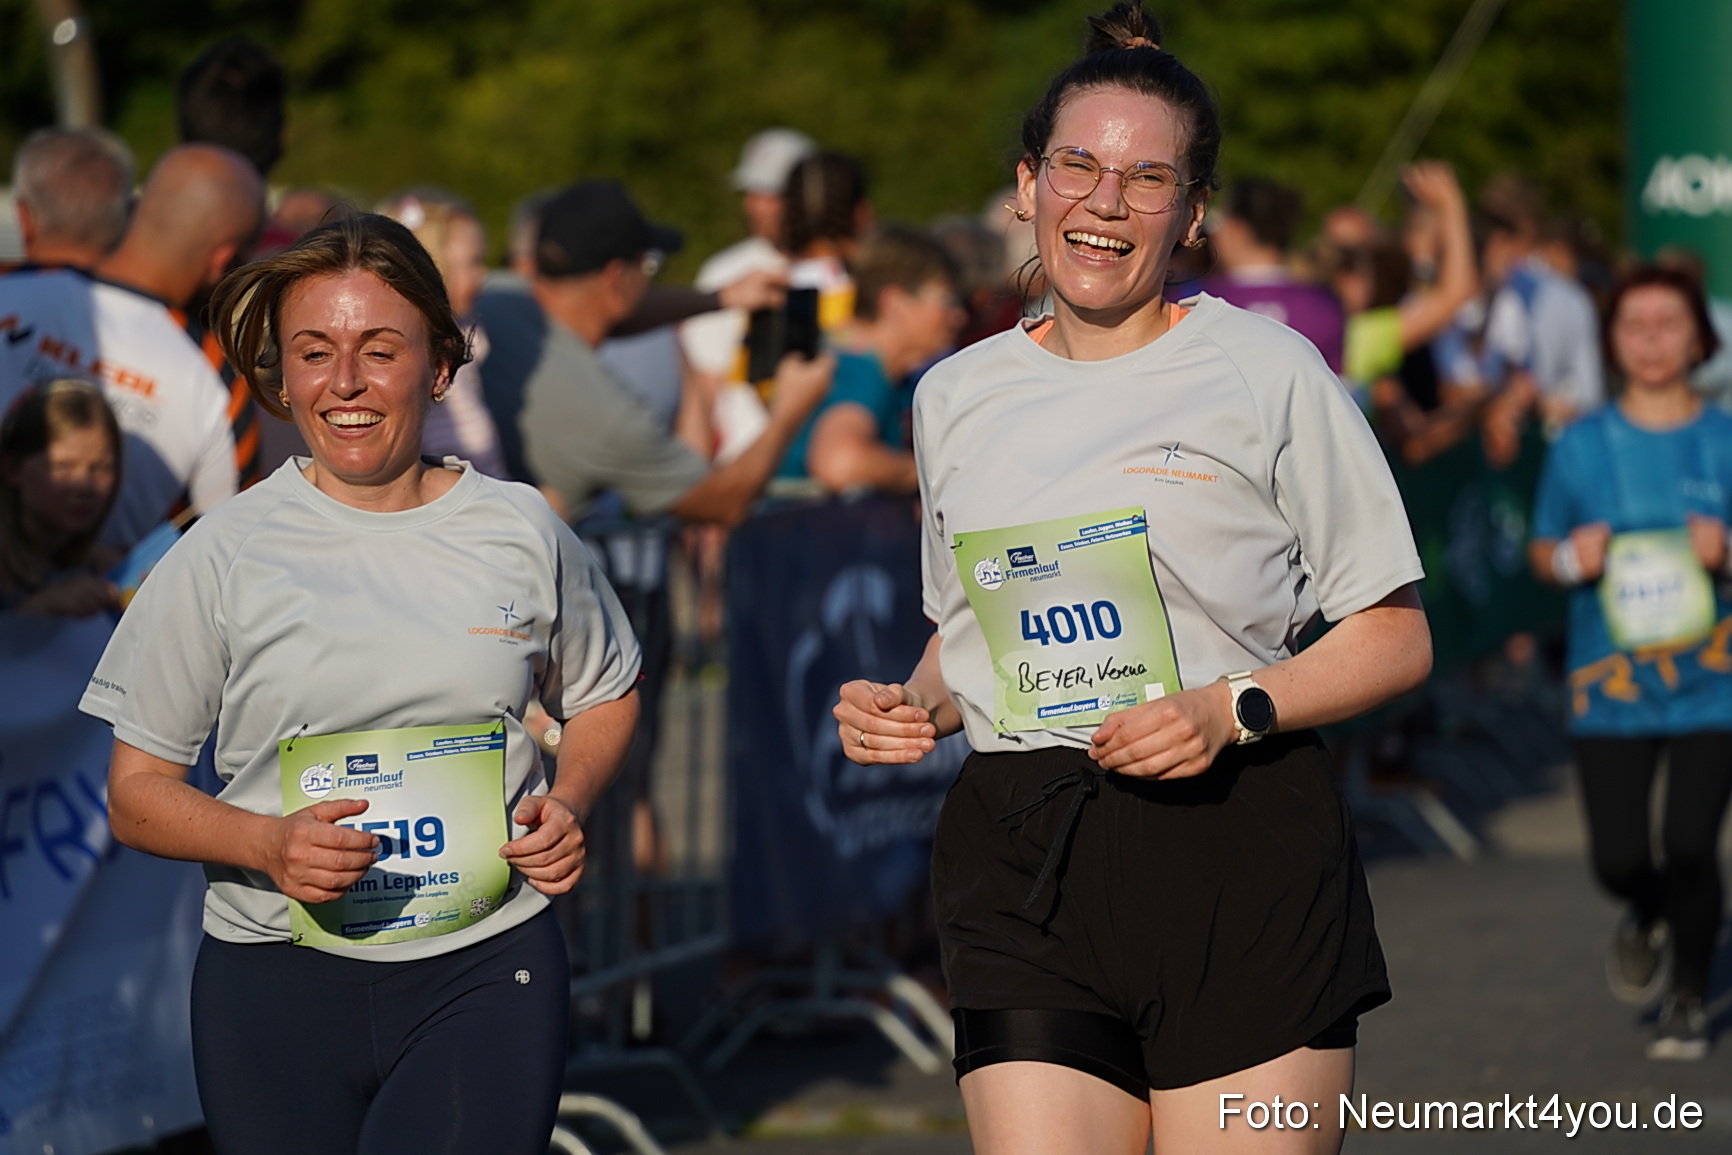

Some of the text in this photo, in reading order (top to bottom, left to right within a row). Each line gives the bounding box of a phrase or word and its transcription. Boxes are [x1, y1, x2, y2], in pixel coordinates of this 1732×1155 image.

[1123, 466, 1219, 483] LOGOPÄDIE NEUMARKT
[1005, 560, 1059, 580] Firmenlauf
[1030, 570, 1062, 582] neumarkt
[1020, 600, 1122, 646] 4010
[1040, 701, 1097, 717] firmenlauf.bayern
[337, 769, 404, 788] Firmenlauf
[364, 781, 403, 792] neumarkt
[340, 816, 445, 862] 519
[348, 871, 460, 893] im Leppkes
[345, 919, 413, 933] firmenlauf.bayern
